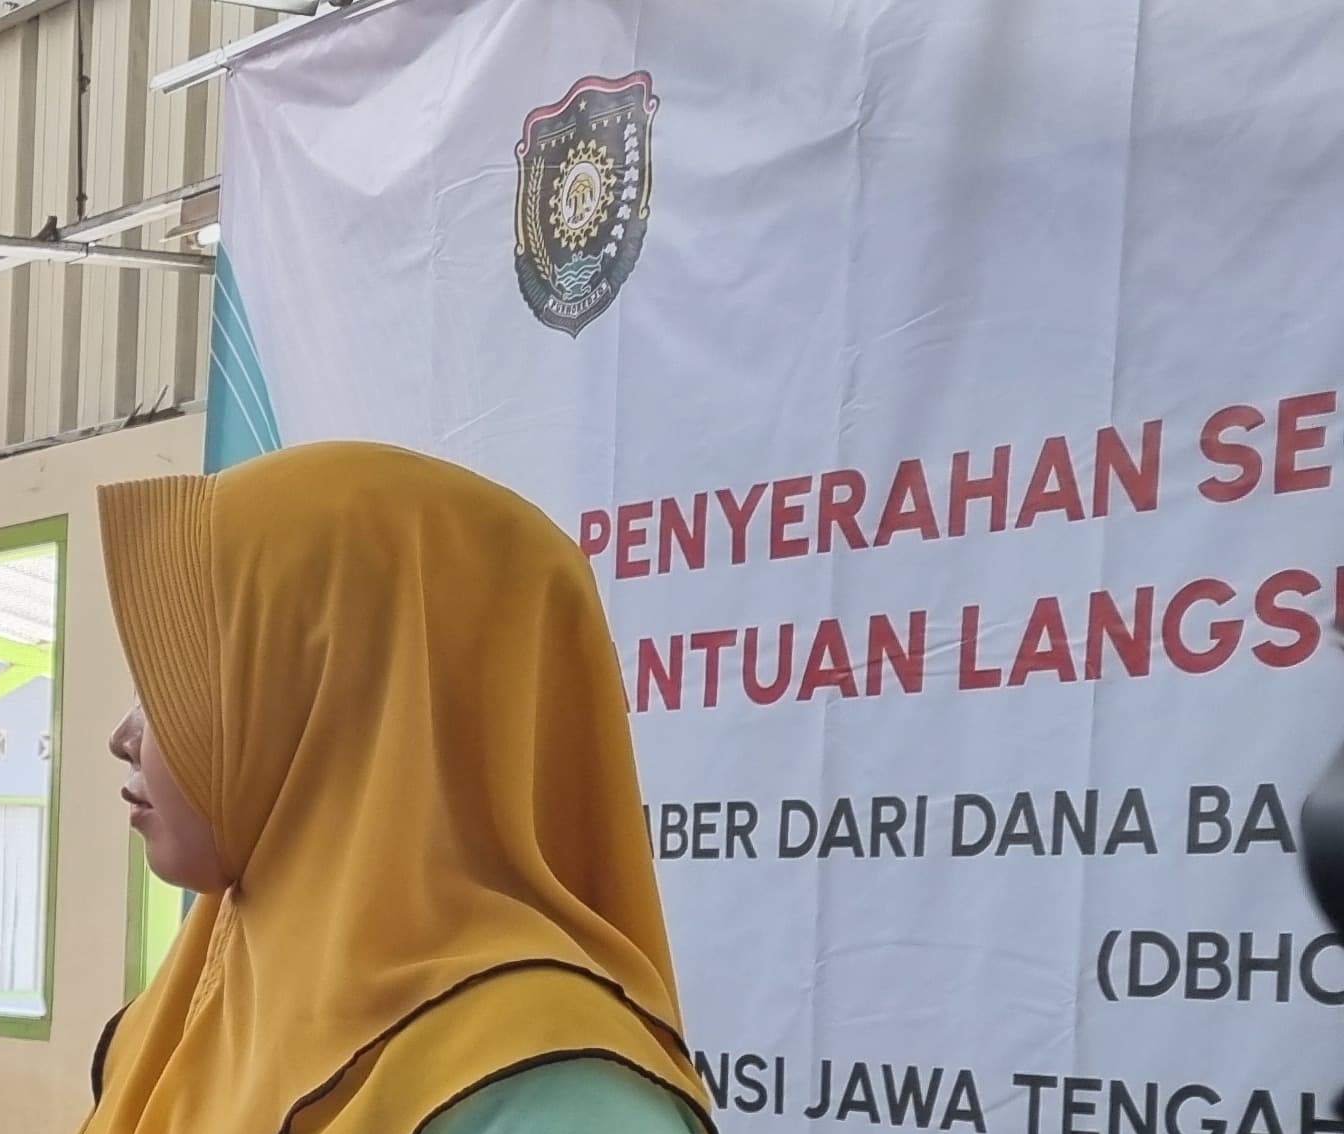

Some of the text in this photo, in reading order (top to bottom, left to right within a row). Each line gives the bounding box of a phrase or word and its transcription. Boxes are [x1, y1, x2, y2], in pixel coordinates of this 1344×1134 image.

[579, 390, 1337, 580] PENYERAHAN SE
[614, 564, 1344, 713] NTUAN LANGS
[643, 783, 1298, 861] BER DARI DANA BA
[804, 1058, 988, 1134] JAWA
